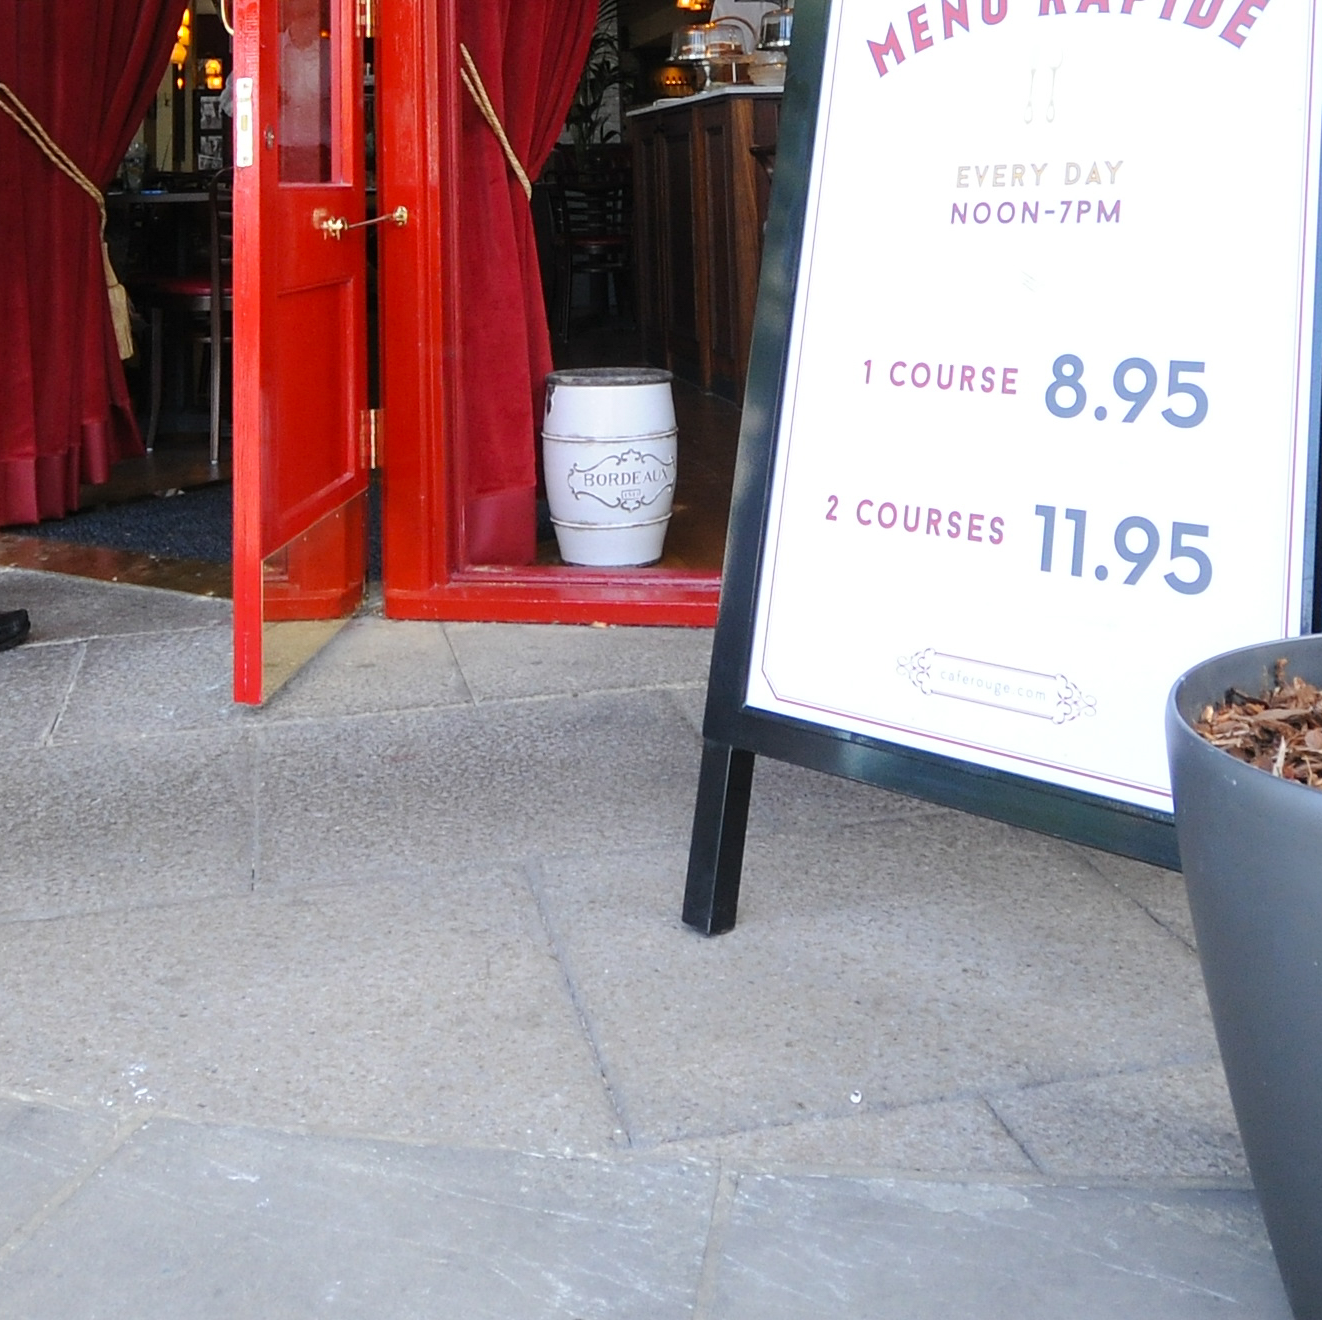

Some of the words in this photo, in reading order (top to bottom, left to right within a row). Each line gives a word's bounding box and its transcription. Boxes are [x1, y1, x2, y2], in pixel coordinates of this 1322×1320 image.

[956, 162, 1049, 189] EVERY
[1063, 160, 1124, 186] DAY
[950, 199, 1122, 225] NOON-7PM
[863, 359, 873, 385] 1
[889, 360, 1019, 396] COURSE
[1044, 353, 1209, 429] 8.95
[584, 468, 668, 487] BORDEAUX
[824, 494, 840, 522] 2
[855, 498, 1006, 546] COURSES
[1034, 503, 1213, 596] 11.95
[939, 669, 1047, 702] caferouge.com
